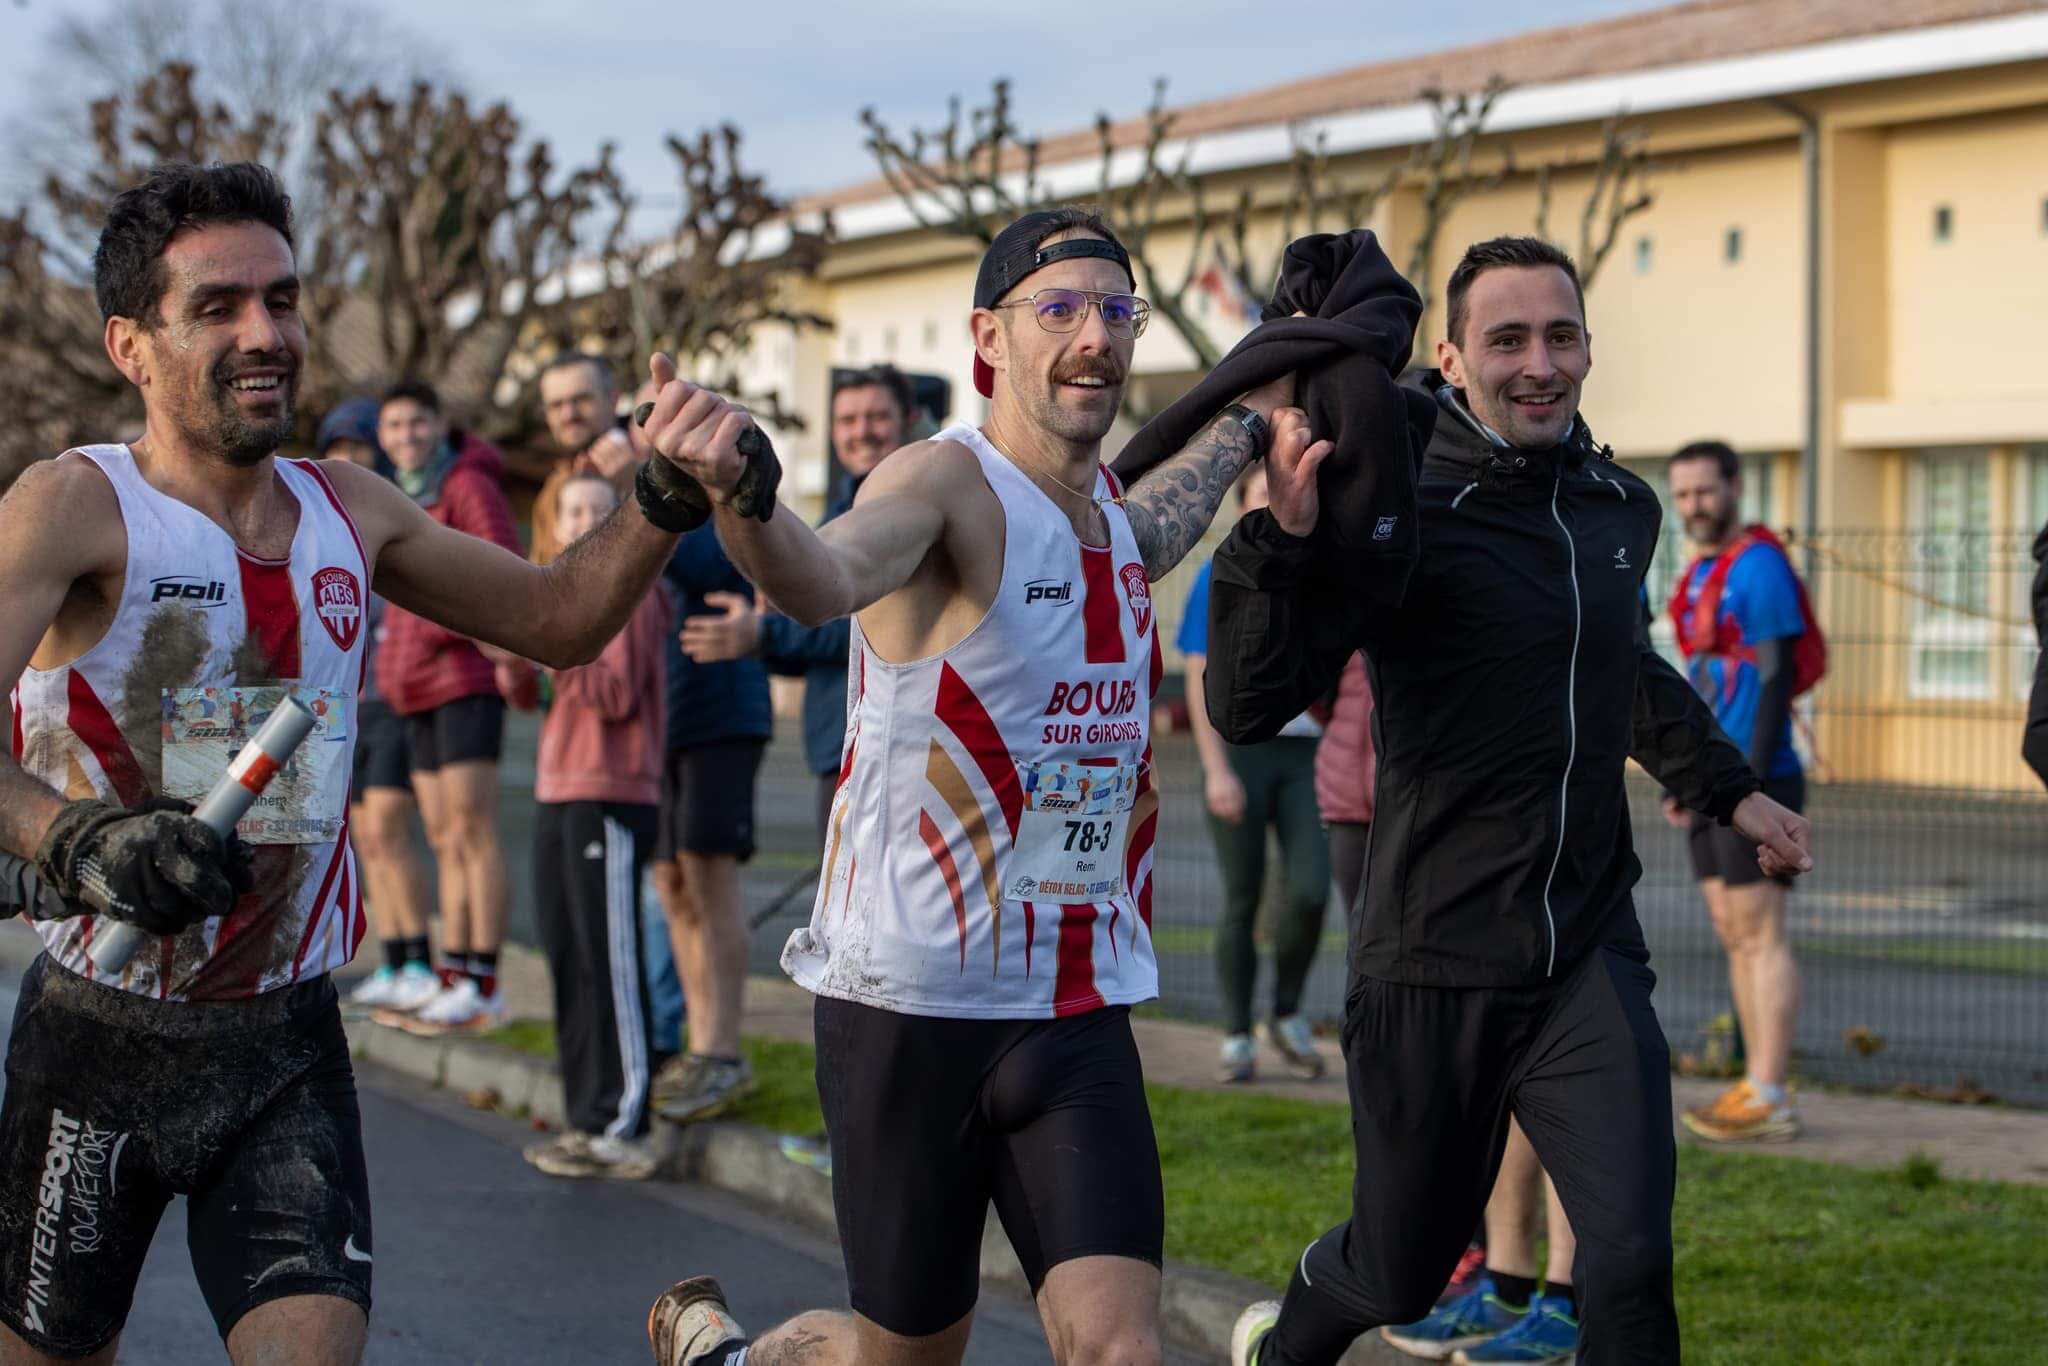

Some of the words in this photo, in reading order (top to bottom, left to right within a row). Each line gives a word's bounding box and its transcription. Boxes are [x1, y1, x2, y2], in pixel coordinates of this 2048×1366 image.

[320, 573, 350, 586] BOURG
[151, 581, 225, 602] poli
[324, 585, 353, 606] ALBS
[1025, 581, 1072, 604] poli
[1042, 724, 1082, 744] SUR
[1086, 721, 1142, 744] GIRONDE
[1063, 820, 1112, 853] 78-3
[1075, 860, 1096, 872] Remi
[68, 1120, 117, 1254] ROCHEFORT
[28, 1107, 80, 1307] INTERSPORT
